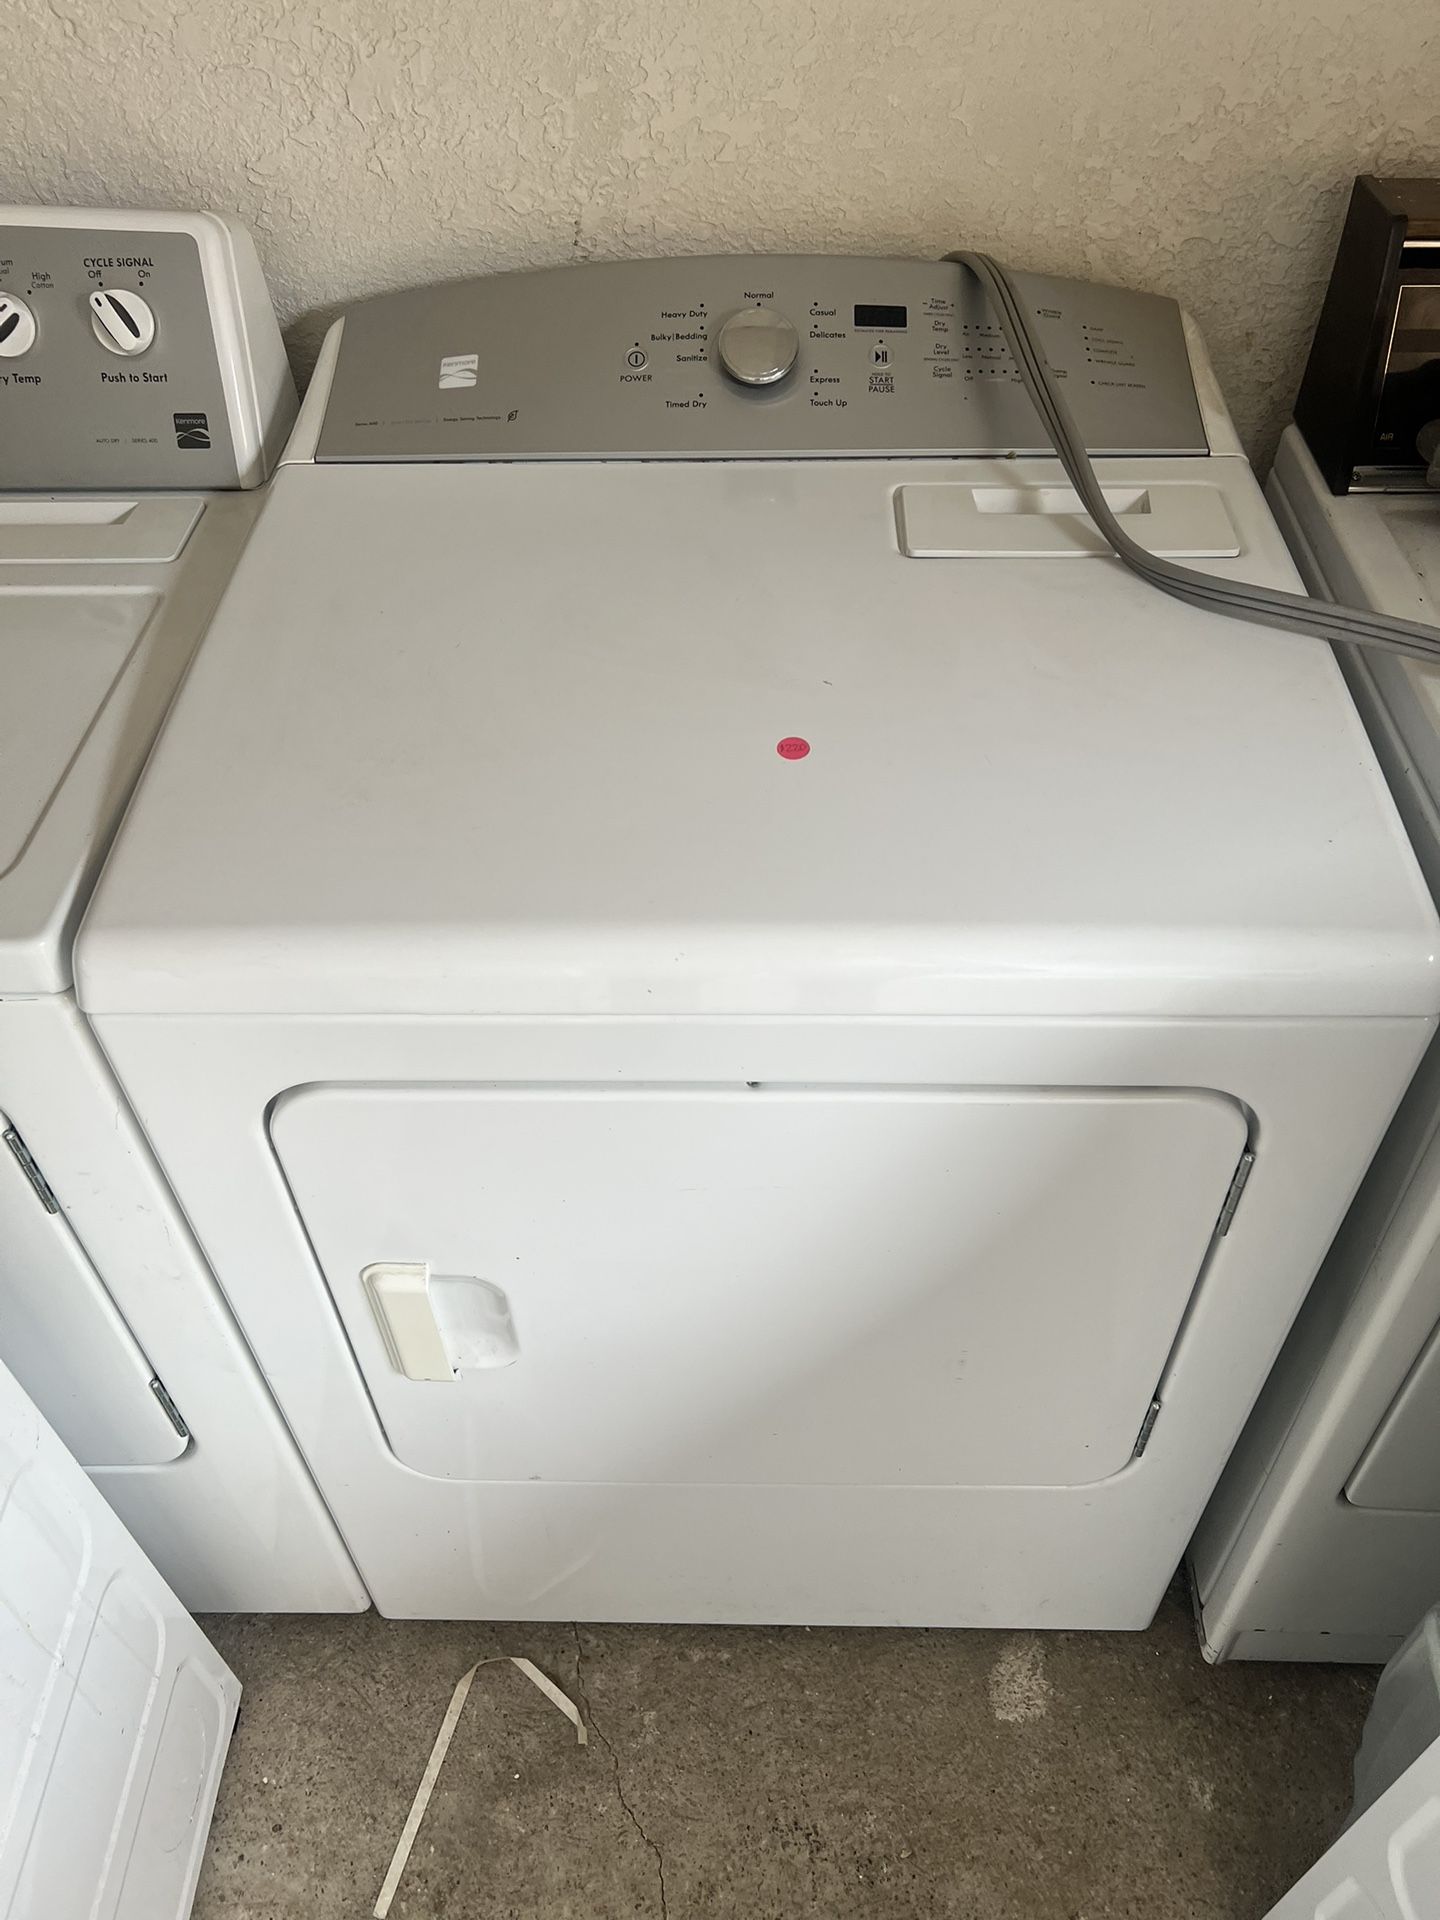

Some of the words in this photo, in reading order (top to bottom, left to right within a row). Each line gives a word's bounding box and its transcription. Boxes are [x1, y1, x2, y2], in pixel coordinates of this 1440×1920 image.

[83, 258, 114, 267] CYCLE
[116, 257, 154, 267] SIGNAL
[32, 272, 51, 282] High
[88, 270, 102, 278] Off
[138, 270, 151, 278] On
[744, 291, 774, 299] Normal
[661, 311, 687, 320] Heavy
[690, 310, 708, 319] Duty
[810, 308, 836, 316] Casual
[810, 331, 846, 339] Delicates
[676, 354, 708, 362] Sanitize
[12, 373, 41, 386] Temp
[101, 373, 126, 383] Push
[129, 373, 139, 383] to
[143, 373, 168, 383] Start
[620, 374, 652, 382] POWER
[810, 376, 840, 384] Express
[869, 376, 894, 384] START
[868, 385, 895, 393] PAUSE
[665, 400, 690, 408] Timed
[692, 400, 707, 409] Dry
[810, 399, 833, 407] Touch
[836, 400, 848, 408] Up
[1380, 432, 1394, 441] AIR
